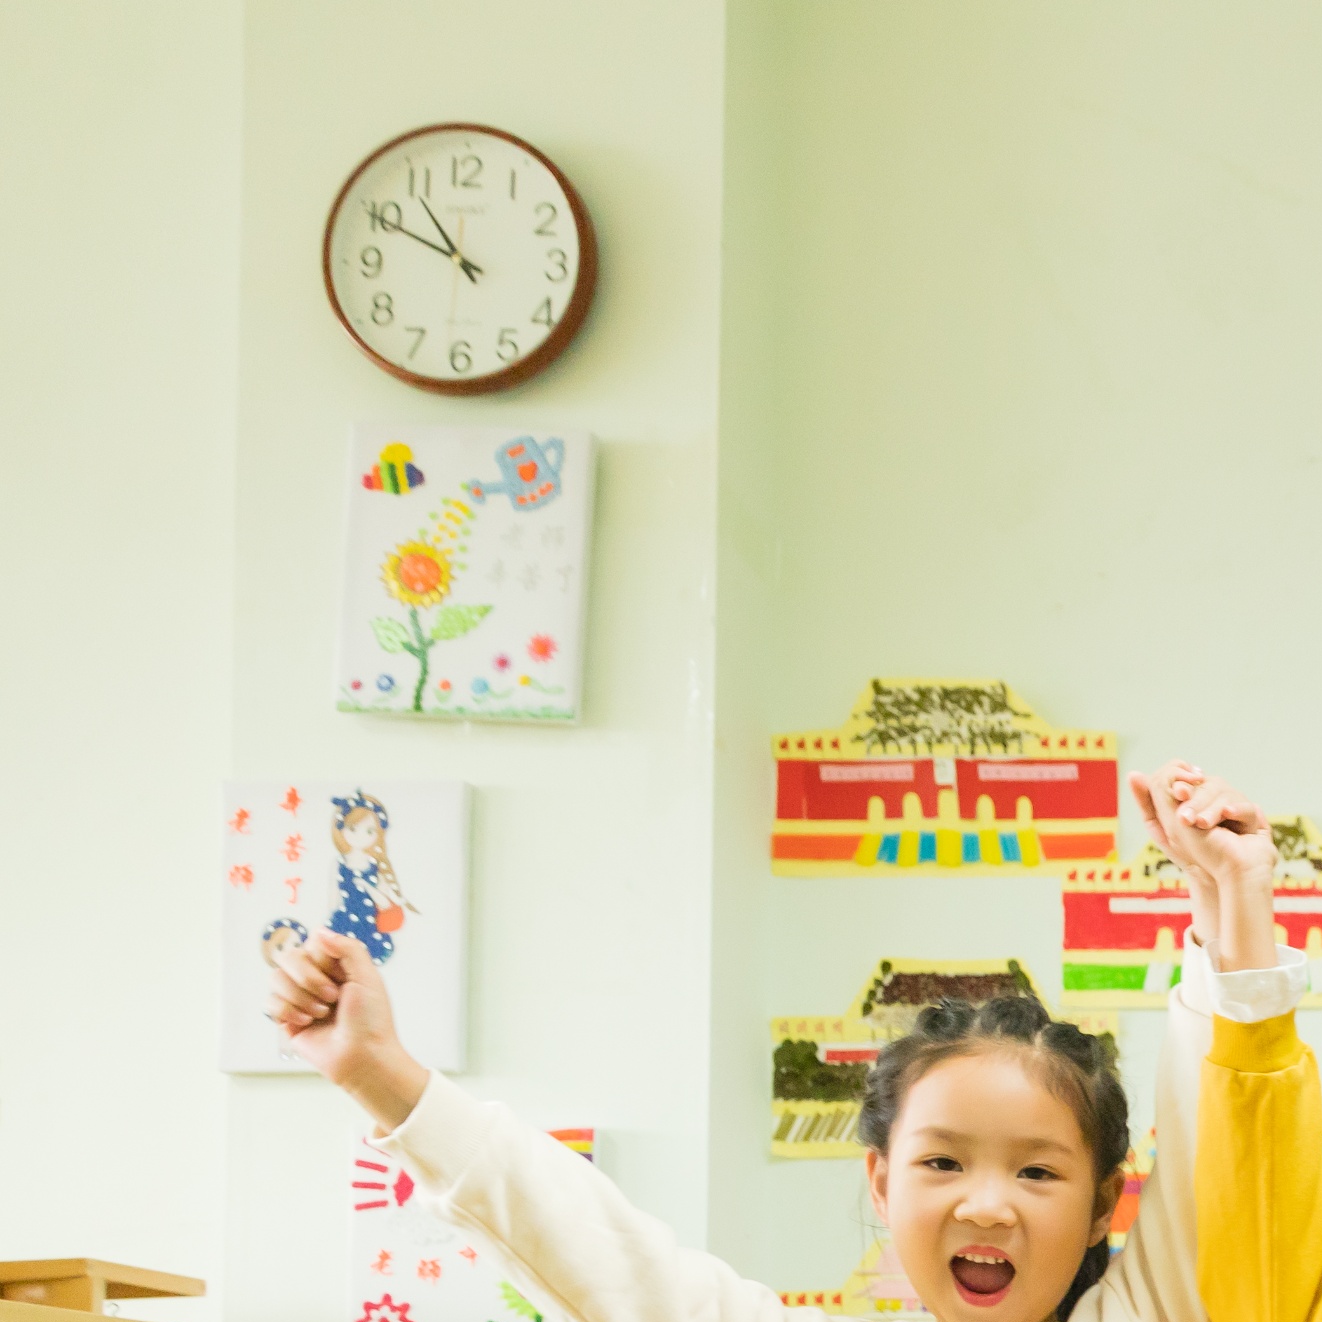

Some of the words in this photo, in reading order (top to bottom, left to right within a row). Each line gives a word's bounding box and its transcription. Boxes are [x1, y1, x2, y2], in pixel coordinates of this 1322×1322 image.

[408, 166, 431, 199] 11
[451, 154, 484, 188] 12
[509, 168, 517, 200] 1
[370, 199, 402, 233] 10
[534, 201, 558, 236] 2
[360, 246, 383, 279] 9
[544, 248, 568, 282] 3
[371, 291, 394, 327] 8
[530, 296, 555, 328] 4
[404, 326, 426, 360] 7
[449, 340, 472, 373] 6
[496, 327, 519, 362] 5
